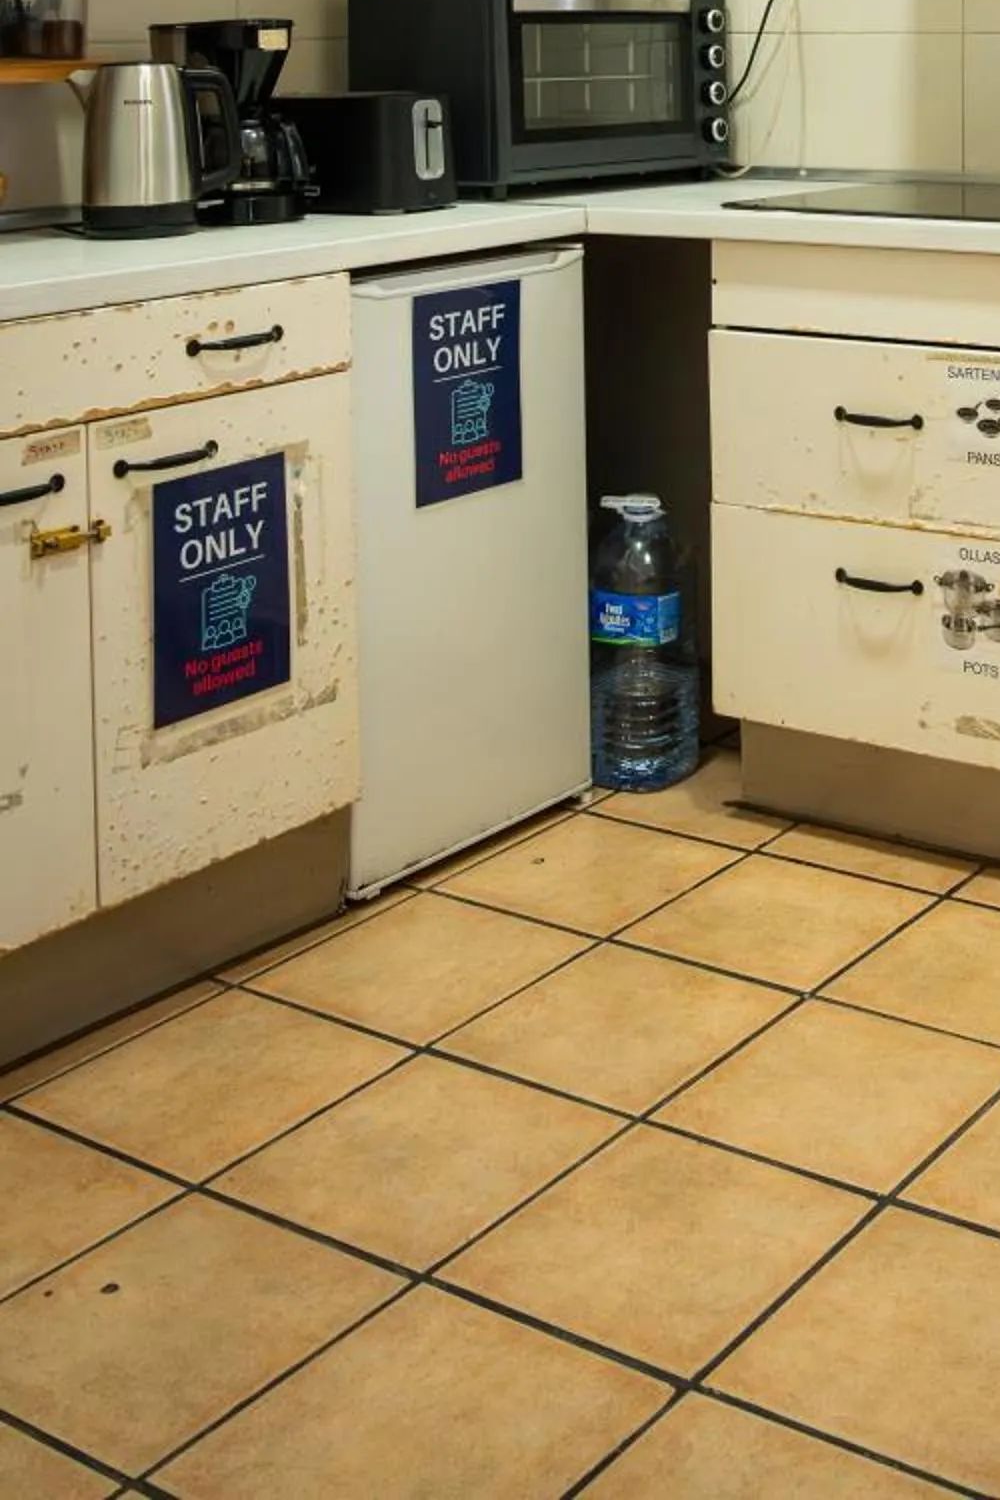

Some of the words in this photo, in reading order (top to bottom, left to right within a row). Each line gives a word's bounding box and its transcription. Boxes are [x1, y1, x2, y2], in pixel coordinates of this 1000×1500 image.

[429, 303, 506, 341] STAFF
[433, 337, 502, 373] ONLY
[439, 449, 458, 467] No
[445, 459, 496, 483] allowed
[173, 481, 268, 534] STAFF
[179, 520, 265, 570] ONLY
[959, 547, 1000, 565] OLLAS
[184, 656, 208, 679] No
[210, 640, 264, 672] guests
[193, 658, 256, 697] allowed
[963, 661, 1000, 678] POTS
